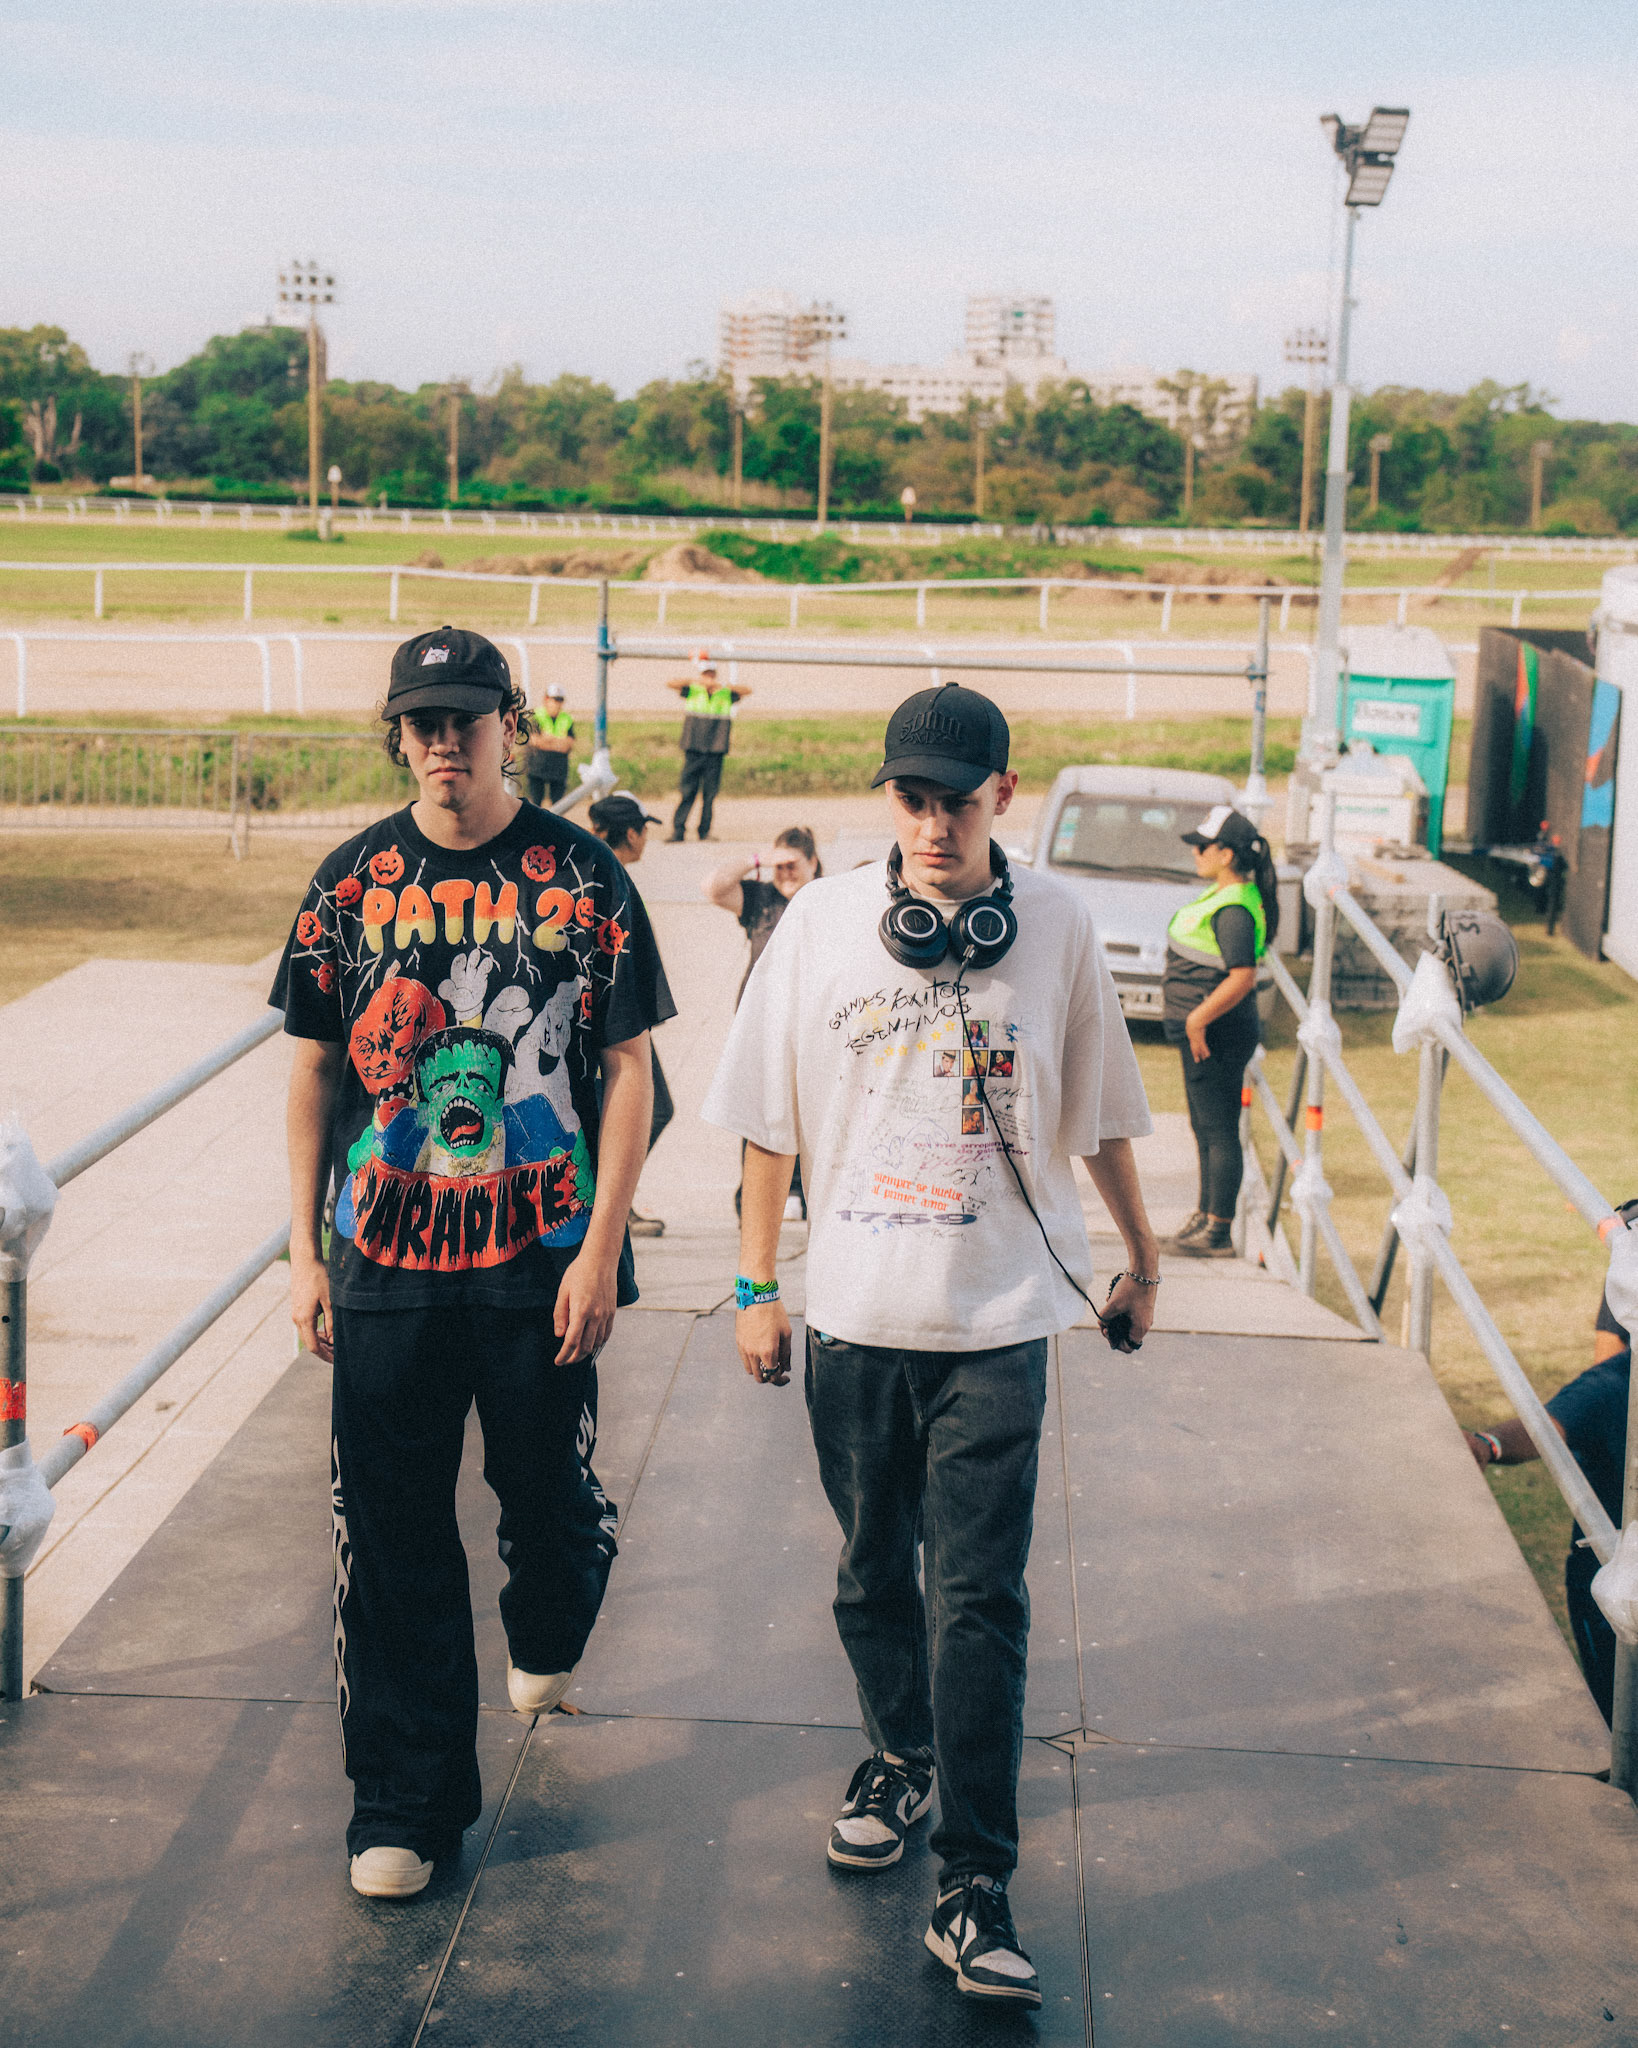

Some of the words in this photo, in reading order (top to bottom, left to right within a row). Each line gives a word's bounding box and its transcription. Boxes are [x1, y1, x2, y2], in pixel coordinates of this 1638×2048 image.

[363, 878, 518, 953] PATH
[532, 887, 576, 952] 2
[354, 1161, 573, 1269] PARADISE
